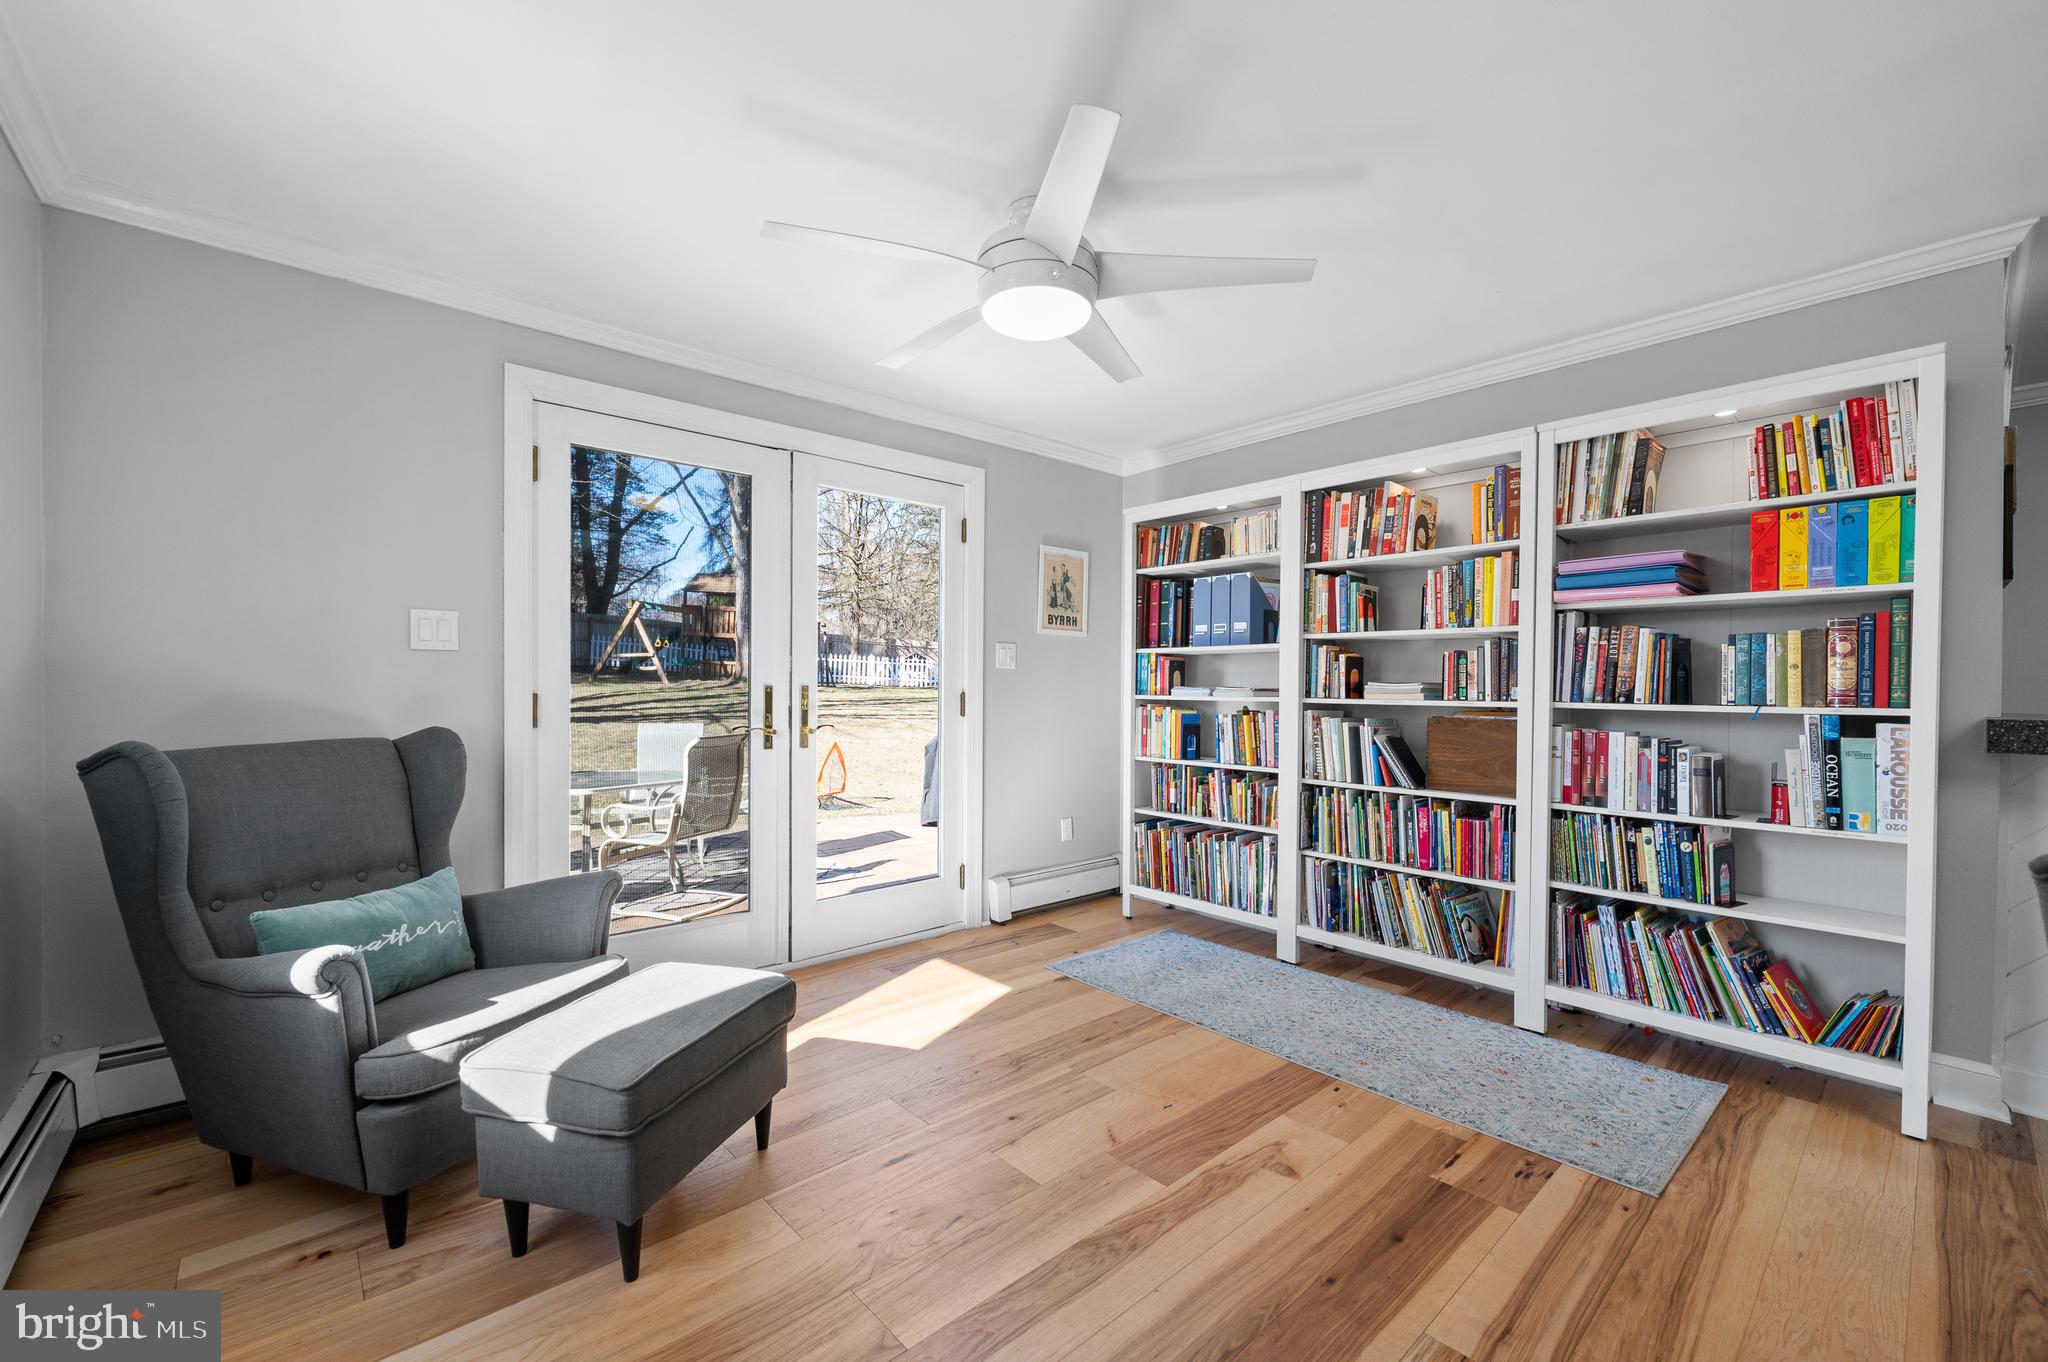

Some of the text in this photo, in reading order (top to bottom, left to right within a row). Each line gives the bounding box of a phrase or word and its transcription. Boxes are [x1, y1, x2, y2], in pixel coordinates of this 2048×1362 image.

[1856, 441, 1863, 450] TO
[1857, 453, 1866, 476] GREAT
[1048, 614, 1078, 626] BYRRH
[1609, 630, 1619, 658] ZEALOT
[1812, 760, 1822, 801] KNOWLEDGE
[1825, 754, 1838, 798] OCEAN
[1890, 727, 1910, 820] LAROUSSE
